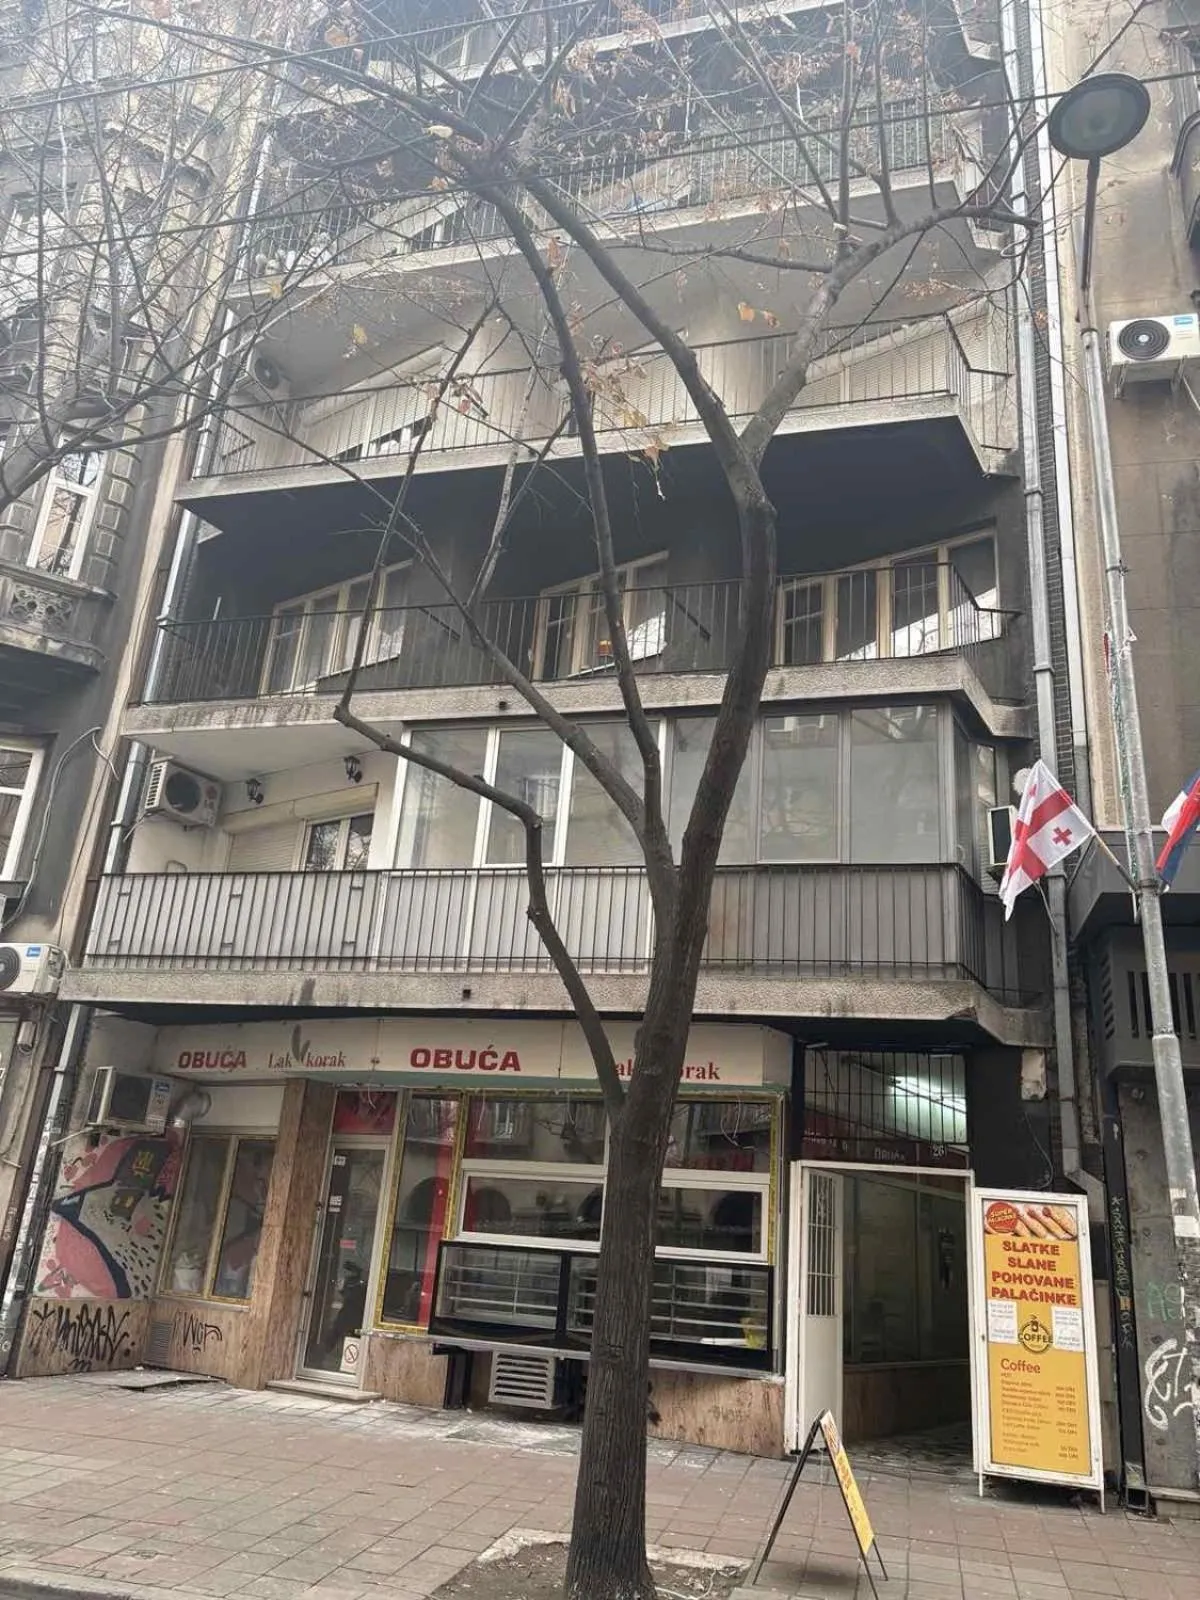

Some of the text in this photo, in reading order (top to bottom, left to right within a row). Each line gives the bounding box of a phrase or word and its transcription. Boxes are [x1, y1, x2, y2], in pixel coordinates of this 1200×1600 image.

[178, 1046, 247, 1069] OBUĆA
[268, 1051, 347, 1069] Lak korak
[410, 1044, 521, 1072] OBUĆA
[1002, 1240, 1060, 1256] SLATKE
[1008, 1257, 1057, 1272] SLANE
[991, 1271, 1075, 1289] POHOVANE
[1018, 1332, 1054, 1344] COFFEE
[1000, 1358, 1041, 1374] Coffee
